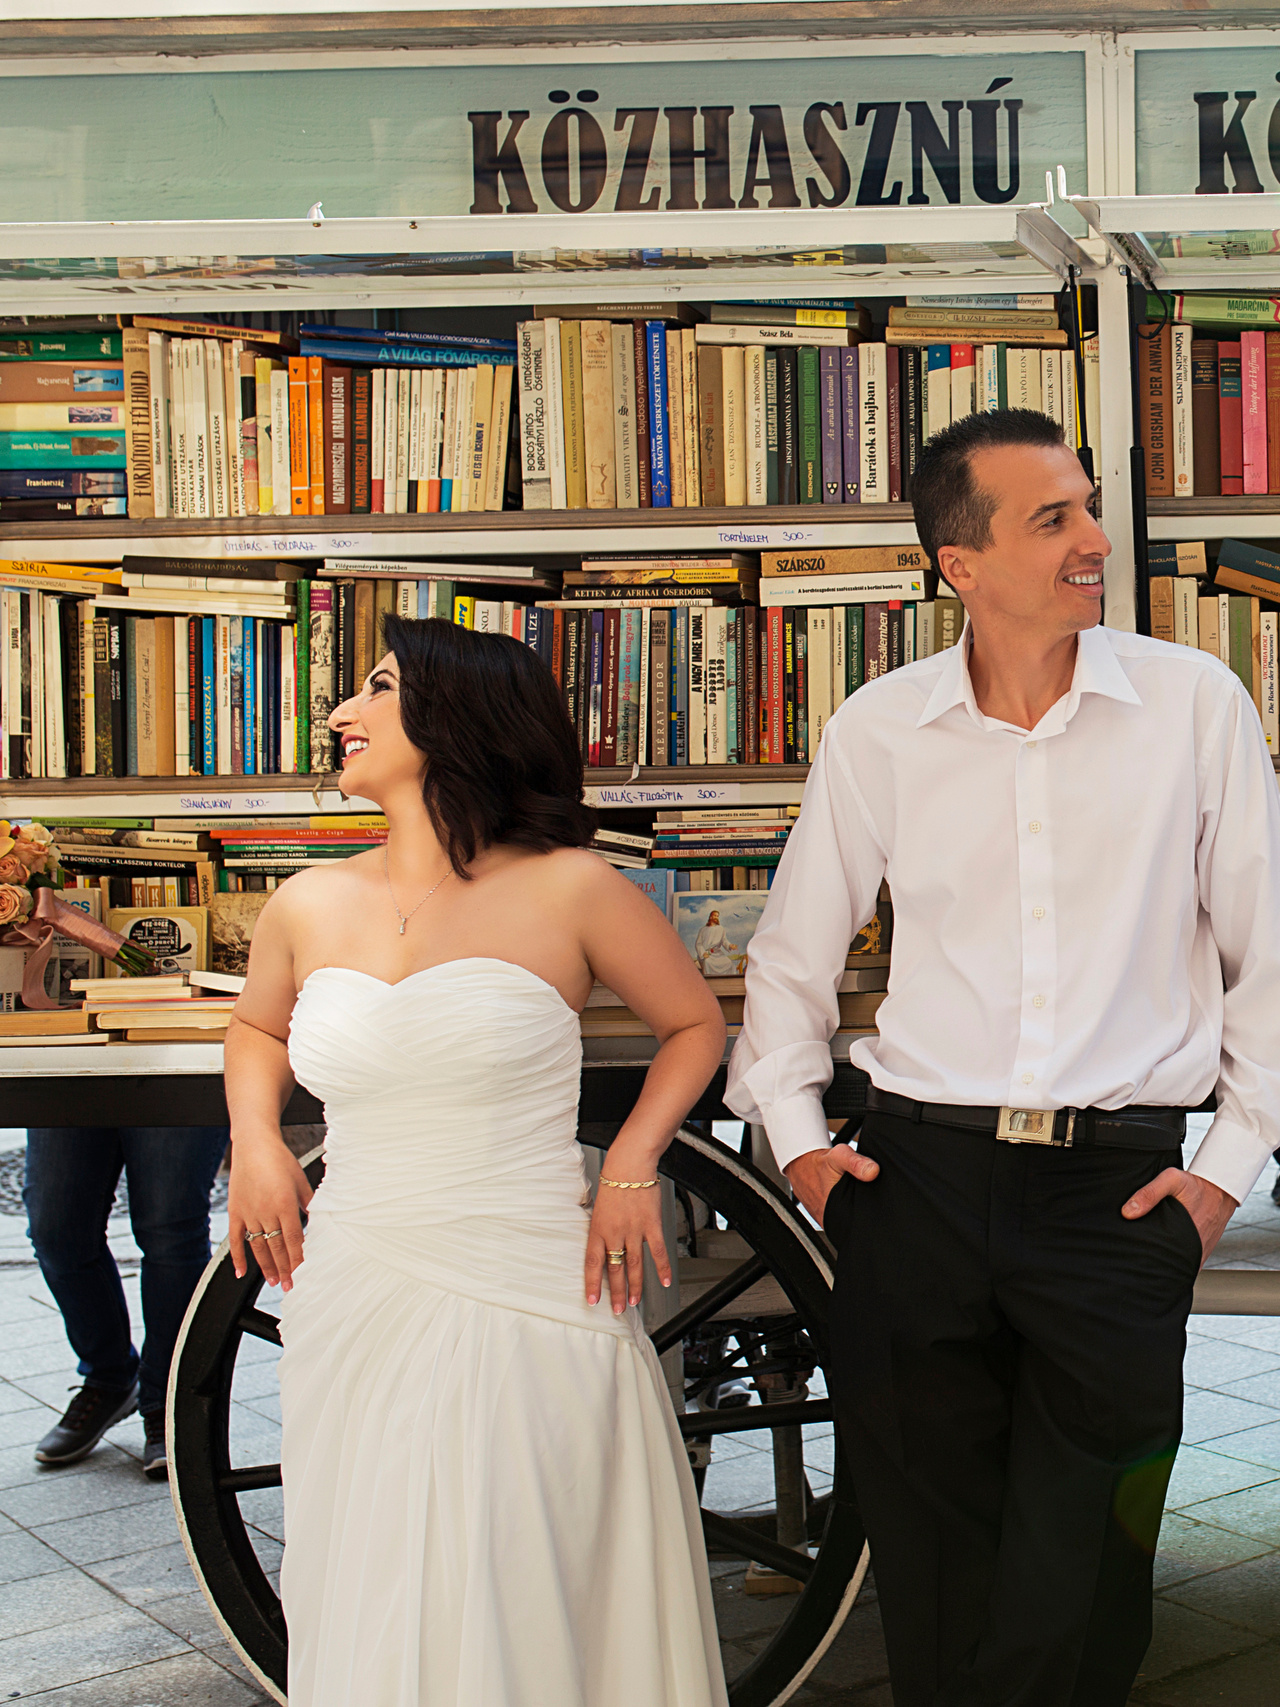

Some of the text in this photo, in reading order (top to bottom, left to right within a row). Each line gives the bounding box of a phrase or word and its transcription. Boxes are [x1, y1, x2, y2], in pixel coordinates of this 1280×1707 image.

[468, 77, 1024, 214] KÖZHASZNÚ
[393, 348, 432, 362] VILÁG
[651, 332, 660, 381] TÖRTÉNETE
[635, 327, 647, 434] Bujdosó nyelvemlékeink
[1150, 376, 1163, 397] DER
[653, 382, 663, 434] CSERKÉSZET
[1150, 402, 1164, 449] GRISHAM
[130, 371, 152, 497] FORDÍTOTT FÉLHOLD
[331, 376, 345, 504] MAGYARORSZÁGI KIRÁNDULÁSOK
[525, 412, 536, 471] BOROS JÁNOS
[533, 397, 546, 471] RAPCSÁNYI LÁSZLÓ
[656, 434, 664, 469] MAGYAR
[864, 381, 879, 489] Barátok a bajban
[1151, 453, 1164, 480] JOHN
[718, 530, 769, 544] TÖRTÉNELEM
[776, 552, 922, 573] SZÁRSZÓ 1943
[575, 585, 712, 598] KETTEN AZ AFRIKAI ŐSERDŐBEN
[110, 625, 120, 659] SOPRON
[692, 613, 703, 640] VONAL
[622, 612, 633, 701] Bolgárok és magyarok
[692, 640, 703, 663] IMRE
[692, 664, 703, 686] NAGY
[203, 675, 213, 765] OLASZORSZÁG
[655, 662, 665, 755] MÉRAY TIBOR
[116, 859, 153, 867] KLASSZIKUS
